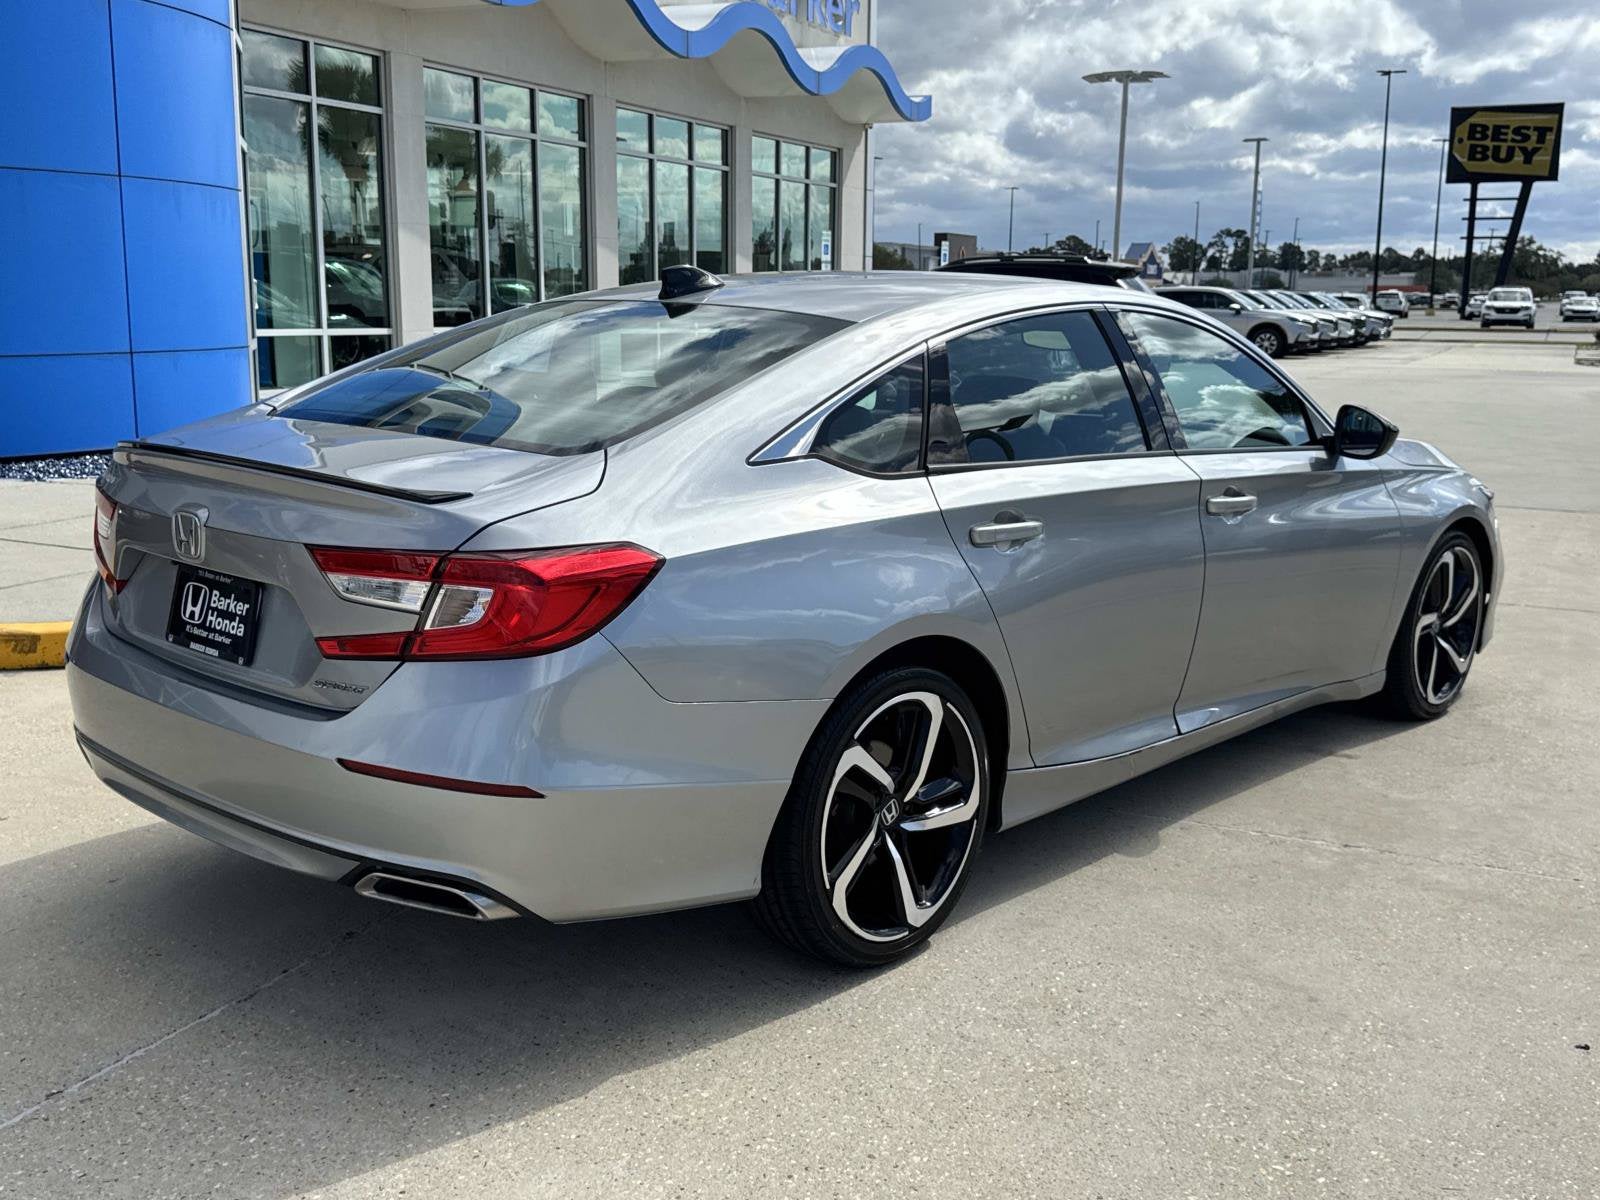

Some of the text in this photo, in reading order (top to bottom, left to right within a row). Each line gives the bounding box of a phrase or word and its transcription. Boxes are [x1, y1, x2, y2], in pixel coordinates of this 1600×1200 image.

[1468, 123, 1554, 144] BEST
[1467, 144, 1543, 165] BUY
[210, 590, 249, 616] Barker
[206, 610, 245, 637] Honda
[208, 633, 215, 641] at
